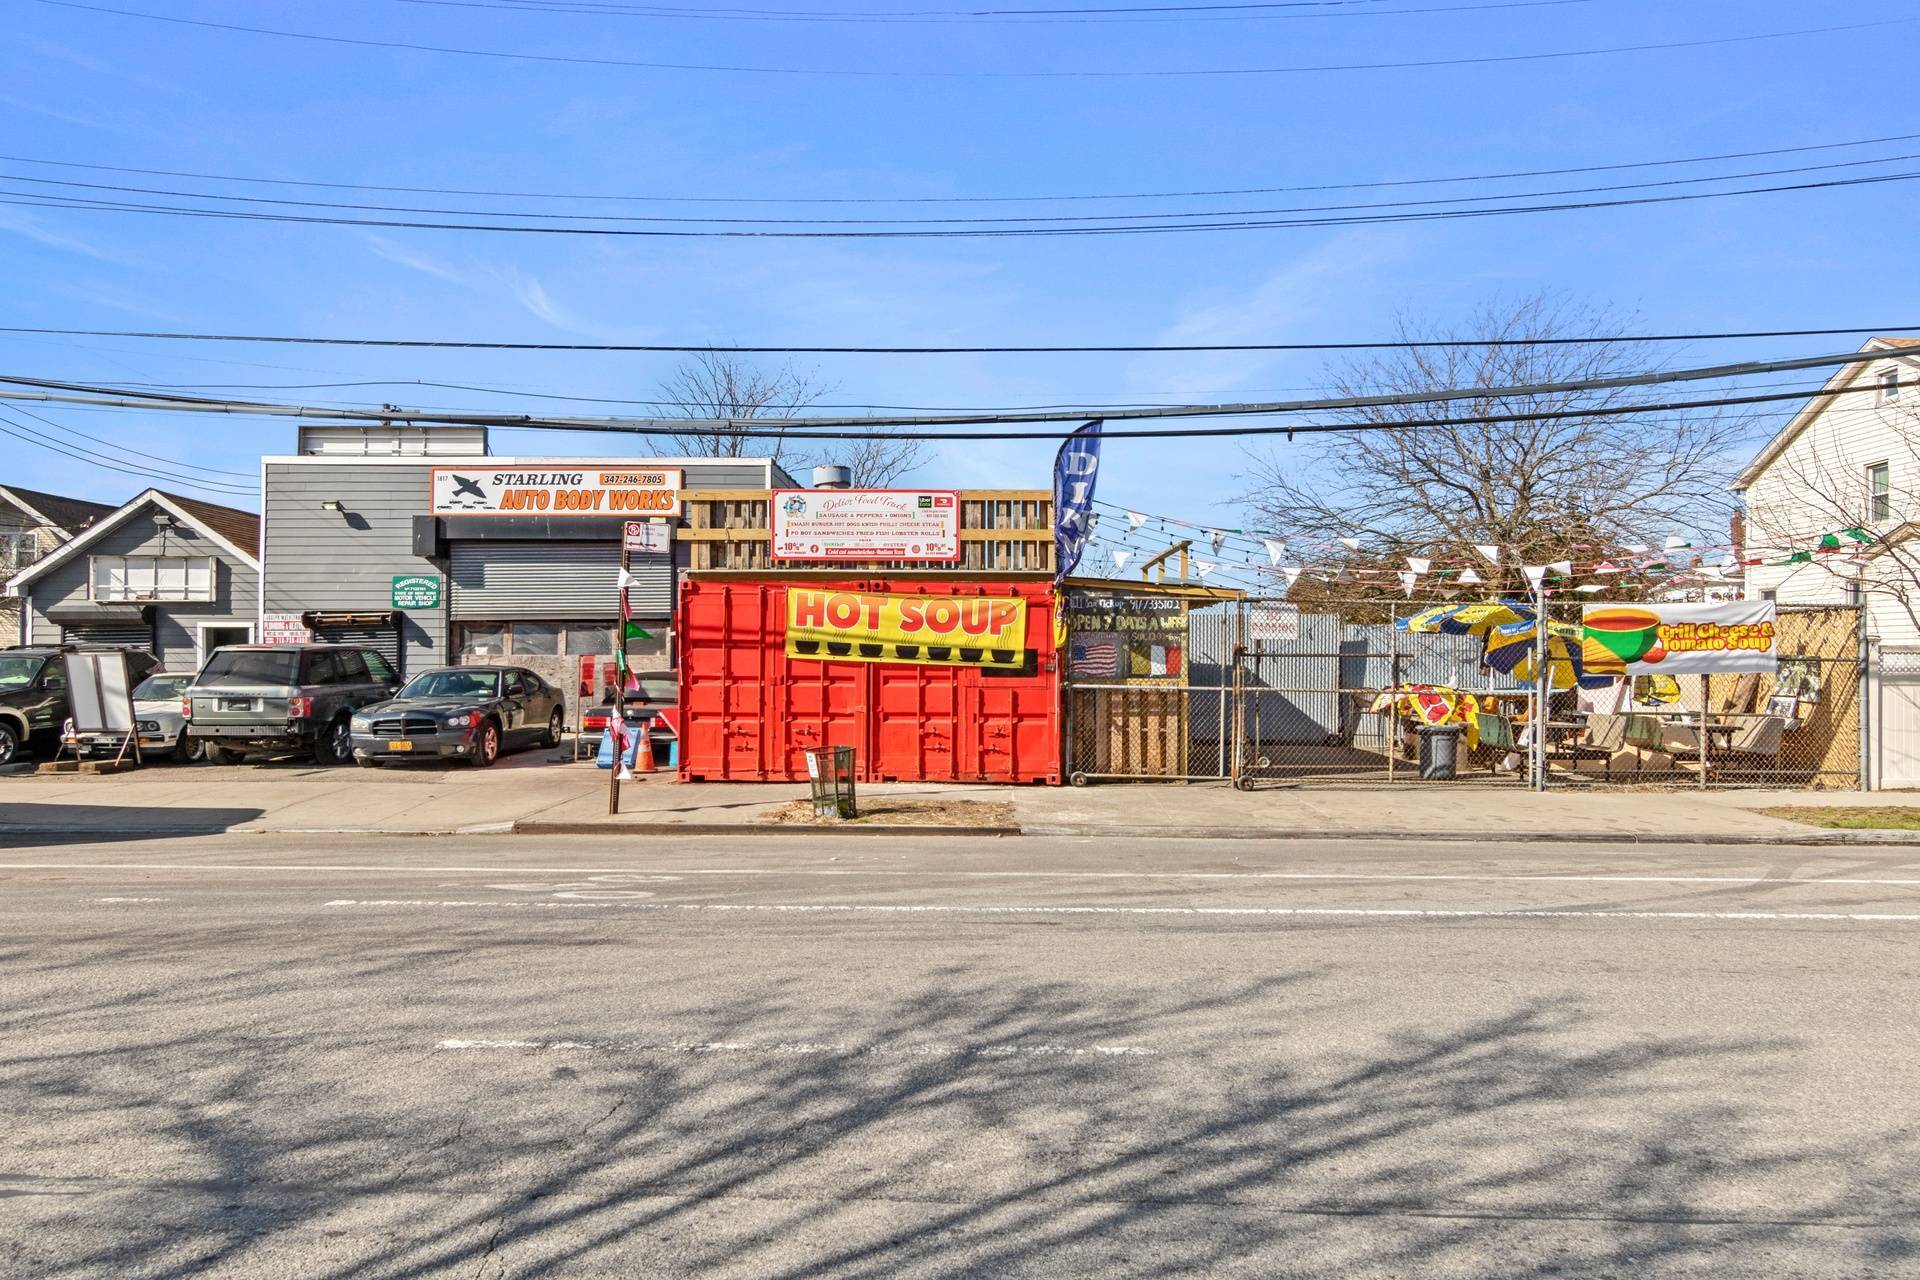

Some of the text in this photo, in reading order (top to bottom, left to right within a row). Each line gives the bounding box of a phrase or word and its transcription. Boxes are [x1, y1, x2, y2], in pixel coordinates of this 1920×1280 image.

[492, 473, 663, 486] STARLING 347-246-7805
[499, 489, 675, 511] AUTO BODY WORKS
[854, 494, 879, 505] Food
[784, 542, 800, 551] 10%
[926, 543, 942, 552] 10%
[395, 578, 438, 589] REGISTERED
[795, 591, 1018, 636] HOT SOUP
[1115, 614, 1149, 630] DAYS
[1149, 615, 1159, 630] A
[1658, 621, 1775, 639] Grill Cheese &
[1661, 636, 1772, 652] Tomato Soup
